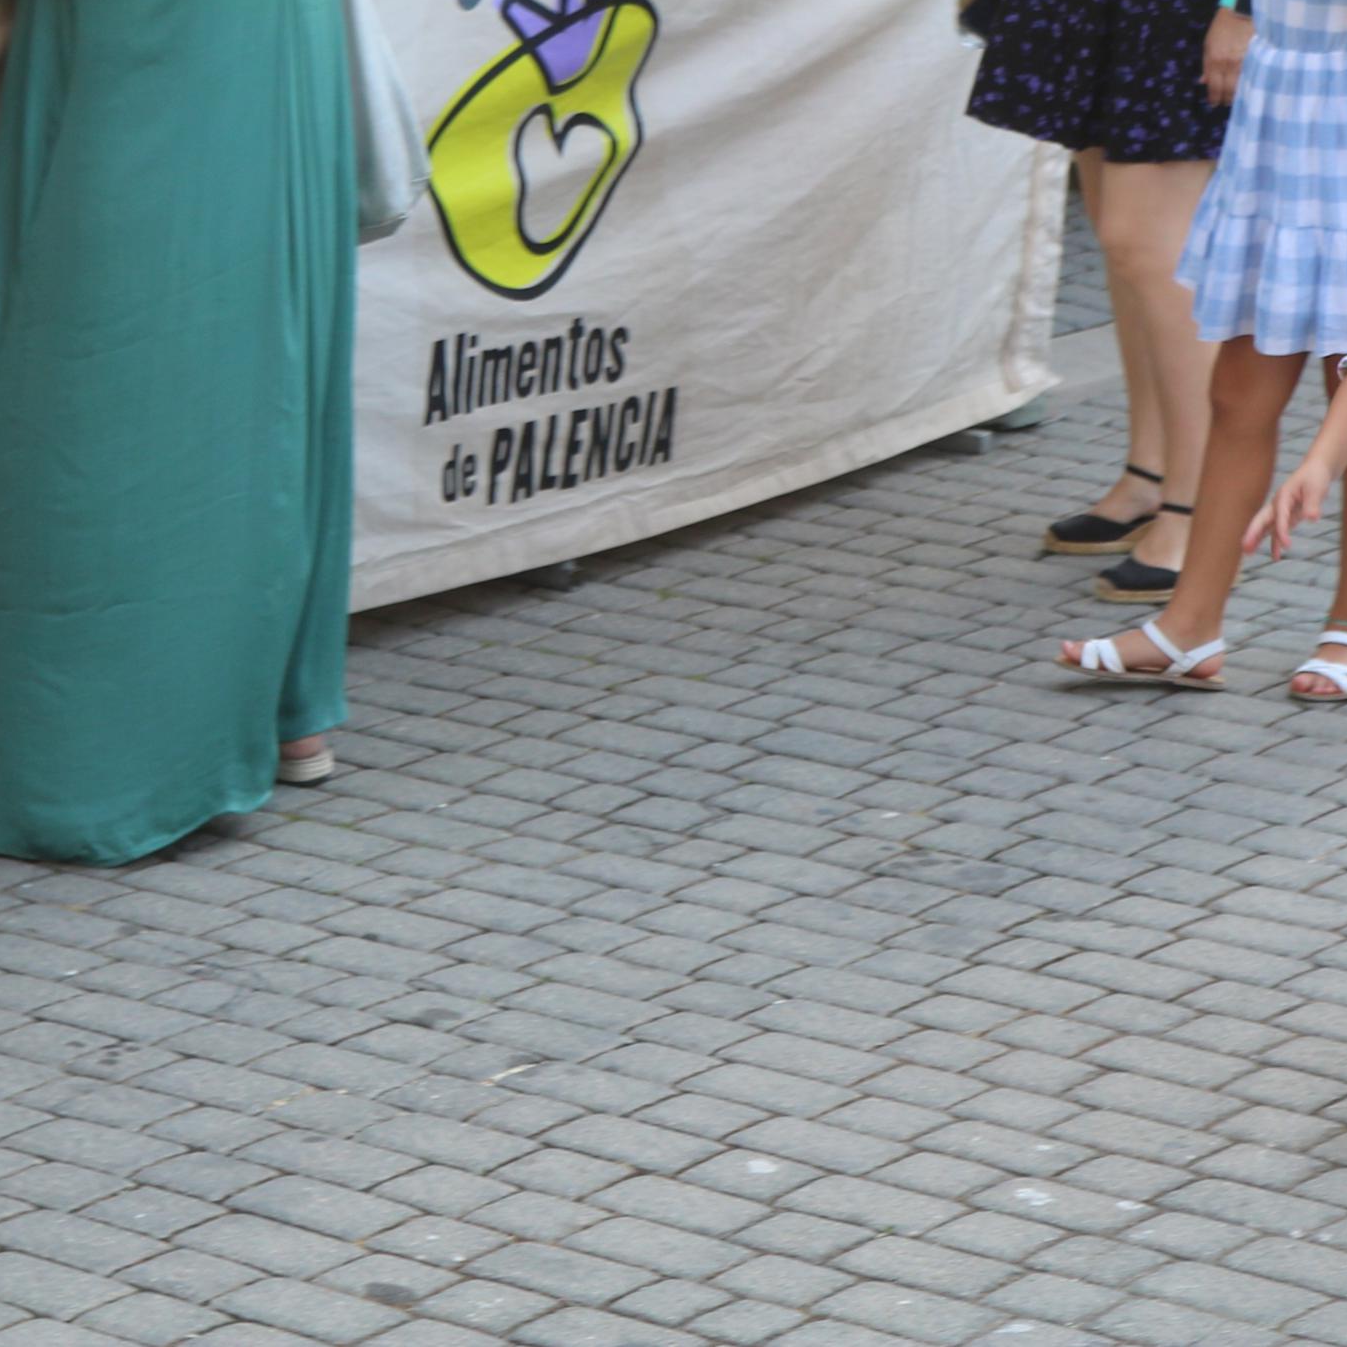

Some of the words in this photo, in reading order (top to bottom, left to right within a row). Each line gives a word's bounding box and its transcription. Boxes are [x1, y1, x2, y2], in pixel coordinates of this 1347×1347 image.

[423, 316, 631, 427] Alimentos
[442, 443, 479, 502] de
[486, 386, 679, 506] PALENCIA
